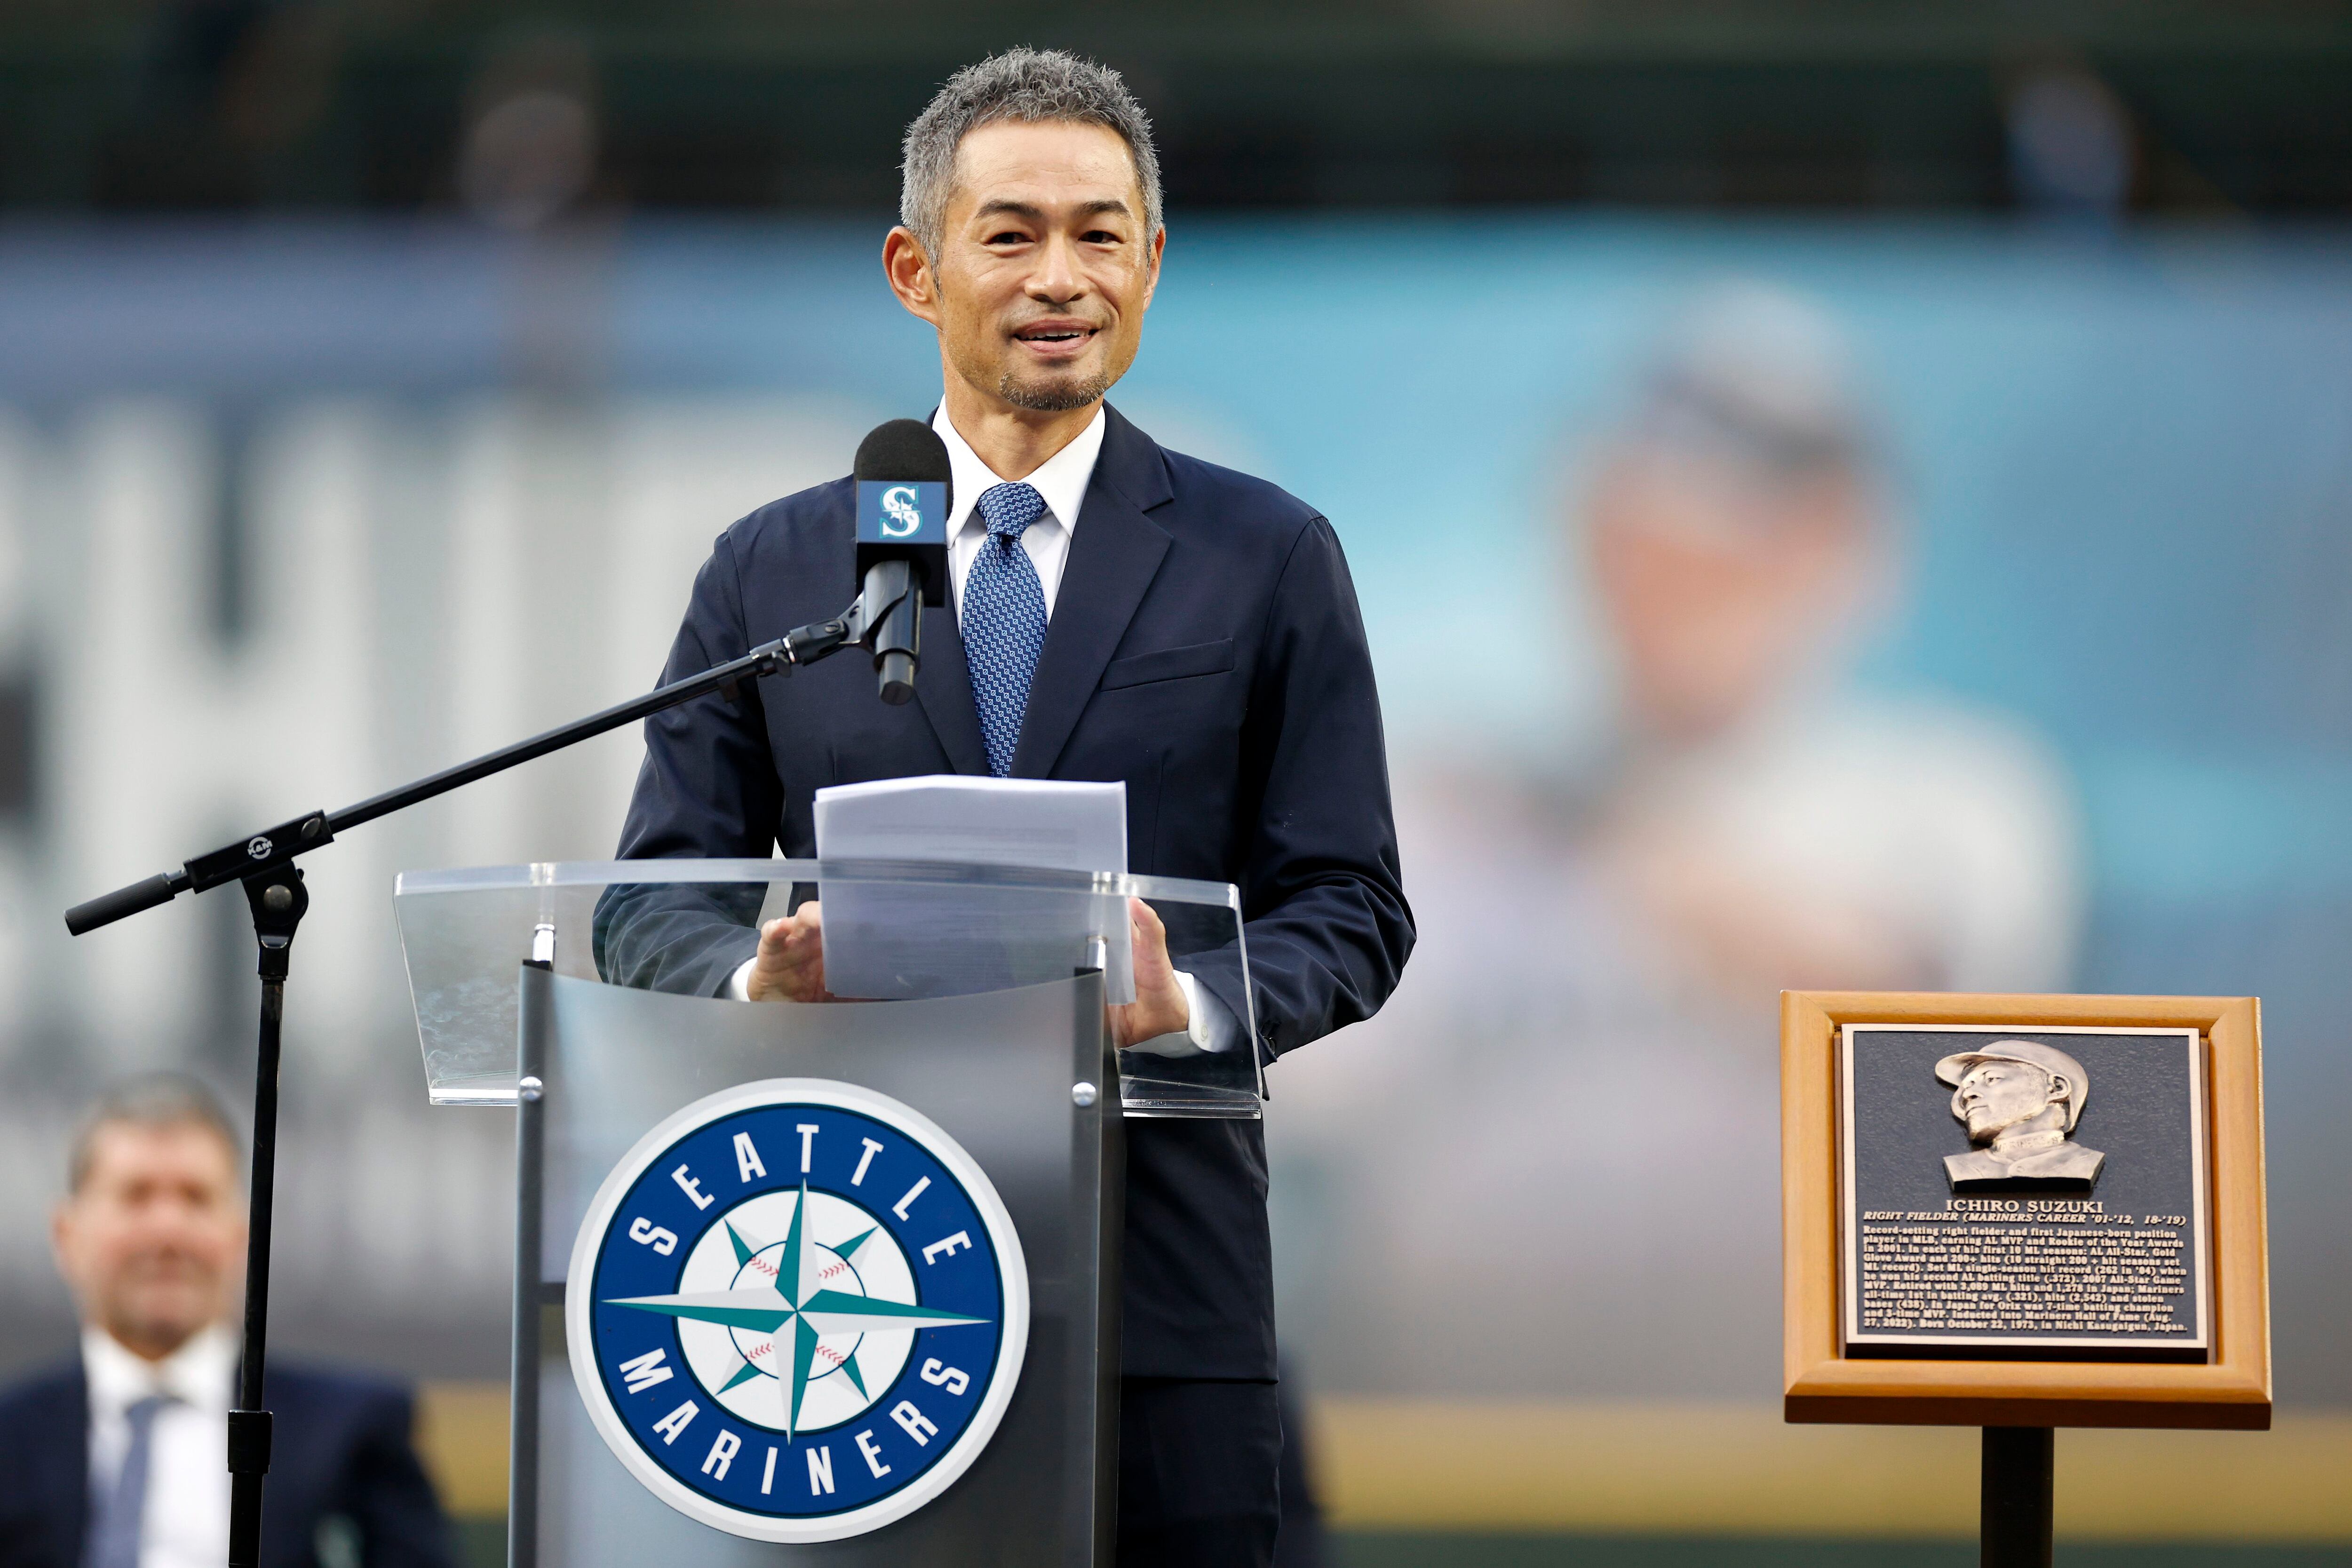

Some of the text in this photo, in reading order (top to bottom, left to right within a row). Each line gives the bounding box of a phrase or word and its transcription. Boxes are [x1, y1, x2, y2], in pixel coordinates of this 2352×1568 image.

[879, 485, 923, 539] S
[247, 840, 273, 856] K&M
[629, 1123, 972, 1266] SEATTLE
[1946, 1200, 2104, 1213] ICHIRO SUZUKI
[1863, 1211, 1904, 1220] RIGHT
[1906, 1212, 1959, 1221] FIELDER
[1962, 1212, 2033, 1223] (MARINERS
[2036, 1214, 2087, 1224] CAREER
[2090, 1214, 2135, 1225] '01-'12,
[1863, 1225, 1939, 1236] Record-setting
[1942, 1226, 1968, 1236] right
[1971, 1227, 2006, 1235] fielder
[2031, 1227, 2053, 1236] first
[2056, 1228, 2131, 1239] Japanese-born
[2134, 1229, 2177, 1240] position
[1863, 1234, 1895, 1245] player
[1899, 1235, 1909, 1243] in
[1913, 1235, 1939, 1245] MLB,
[1941, 1235, 1982, 1246] earning
[2001, 1236, 2023, 1245] MVP
[2026, 1237, 2045, 1245] and
[2049, 1237, 2084, 1246] Rookie
[2100, 1238, 2117, 1246] the
[2147, 1238, 2184, 1247] Awards
[1877, 1244, 1905, 1252] 2001.
[1908, 1244, 1919, 1253] In
[1922, 1245, 1947, 1253] each
[1949, 1245, 1961, 1253] of
[1983, 1245, 2006, 1254] first
[2010, 1246, 2021, 1254] 10
[2090, 1247, 2104, 1255] AL
[2152, 1248, 2175, 1256] Gold
[1863, 1253, 1892, 1261] Glove
[1894, 1253, 1926, 1262] Award
[1929, 1254, 1948, 1262] and
[1951, 1254, 1977, 1263] 200+
[1980, 1255, 2001, 1263] hits
[2003, 1255, 2022, 1265] (10
[2025, 1255, 2066, 1266] straight
[1882, 1262, 1924, 1273] record).
[1947, 1263, 1963, 1272] ML
[1965, 1264, 2036, 1274] single-season
[2040, 1265, 2055, 1273] hit
[2058, 1265, 2091, 1274] record
[2095, 1266, 2118, 1275] (262
[2160, 1266, 2186, 1275] when
[1923, 1272, 1958, 1281] second
[1961, 1273, 1975, 1281] AL
[1977, 1273, 2015, 1283] batting
[2018, 1274, 2040, 1282] title
[2082, 1274, 2106, 1283] 2007
[2110, 1275, 2150, 1283] All-Star
[2153, 1275, 2181, 1284] Game
[1864, 1281, 1890, 1289] MVP.
[1893, 1281, 1931, 1289] Retired
[1934, 1281, 1958, 1290] with
[1992, 1282, 2007, 1291] ML
[2010, 1282, 2031, 1291] hits
[2034, 1283, 2053, 1291] and
[2087, 1284, 2098, 1292] in
[2100, 1284, 2134, 1294] Japan;
[2137, 1285, 2185, 1293] Mariners
[1864, 1290, 1905, 1298] all-time
[1908, 1290, 1923, 1299] 1st
[1927, 1291, 1938, 1299] in
[1940, 1291, 1979, 1301] batting
[1981, 1293, 2002, 1302] avg.
[2045, 1293, 2066, 1301] hits
[2110, 1294, 2129, 1302] and
[2132, 1294, 2164, 1303] stolen
[1864, 1299, 1893, 1308] bases
[1931, 1300, 1943, 1309] In
[1946, 1300, 1976, 1311] Japan
[1979, 1301, 1995, 1309] for
[1997, 1301, 2021, 1310] Orix
[2046, 1302, 2080, 1311] 7-time
[2083, 1303, 2121, 1313] batting
[2123, 1303, 2173, 1313] champion
[1886, 1309, 1920, 1318] 3-time
[1923, 1309, 1949, 1318] MVP.
[1952, 1310, 1997, 1319] Inducted
[2001, 1311, 2022, 1319] into
[2025, 1311, 2072, 1320] Mariners
[2075, 1312, 2096, 1320] Hall
[2113, 1312, 2140, 1321] Fame
[2144, 1313, 2171, 1323] (Aug.
[1864, 1318, 1880, 1328] 27,
[1919, 1319, 1944, 1328] Born
[1947, 1319, 1988, 1328] October
[1991, 1320, 2007, 1330] 22,
[2041, 1321, 2052, 1329] in
[2055, 1321, 2083, 1329] Nichi
[2154, 1322, 2187, 1332] Japan.
[619, 1347, 970, 1496] MARINERS
